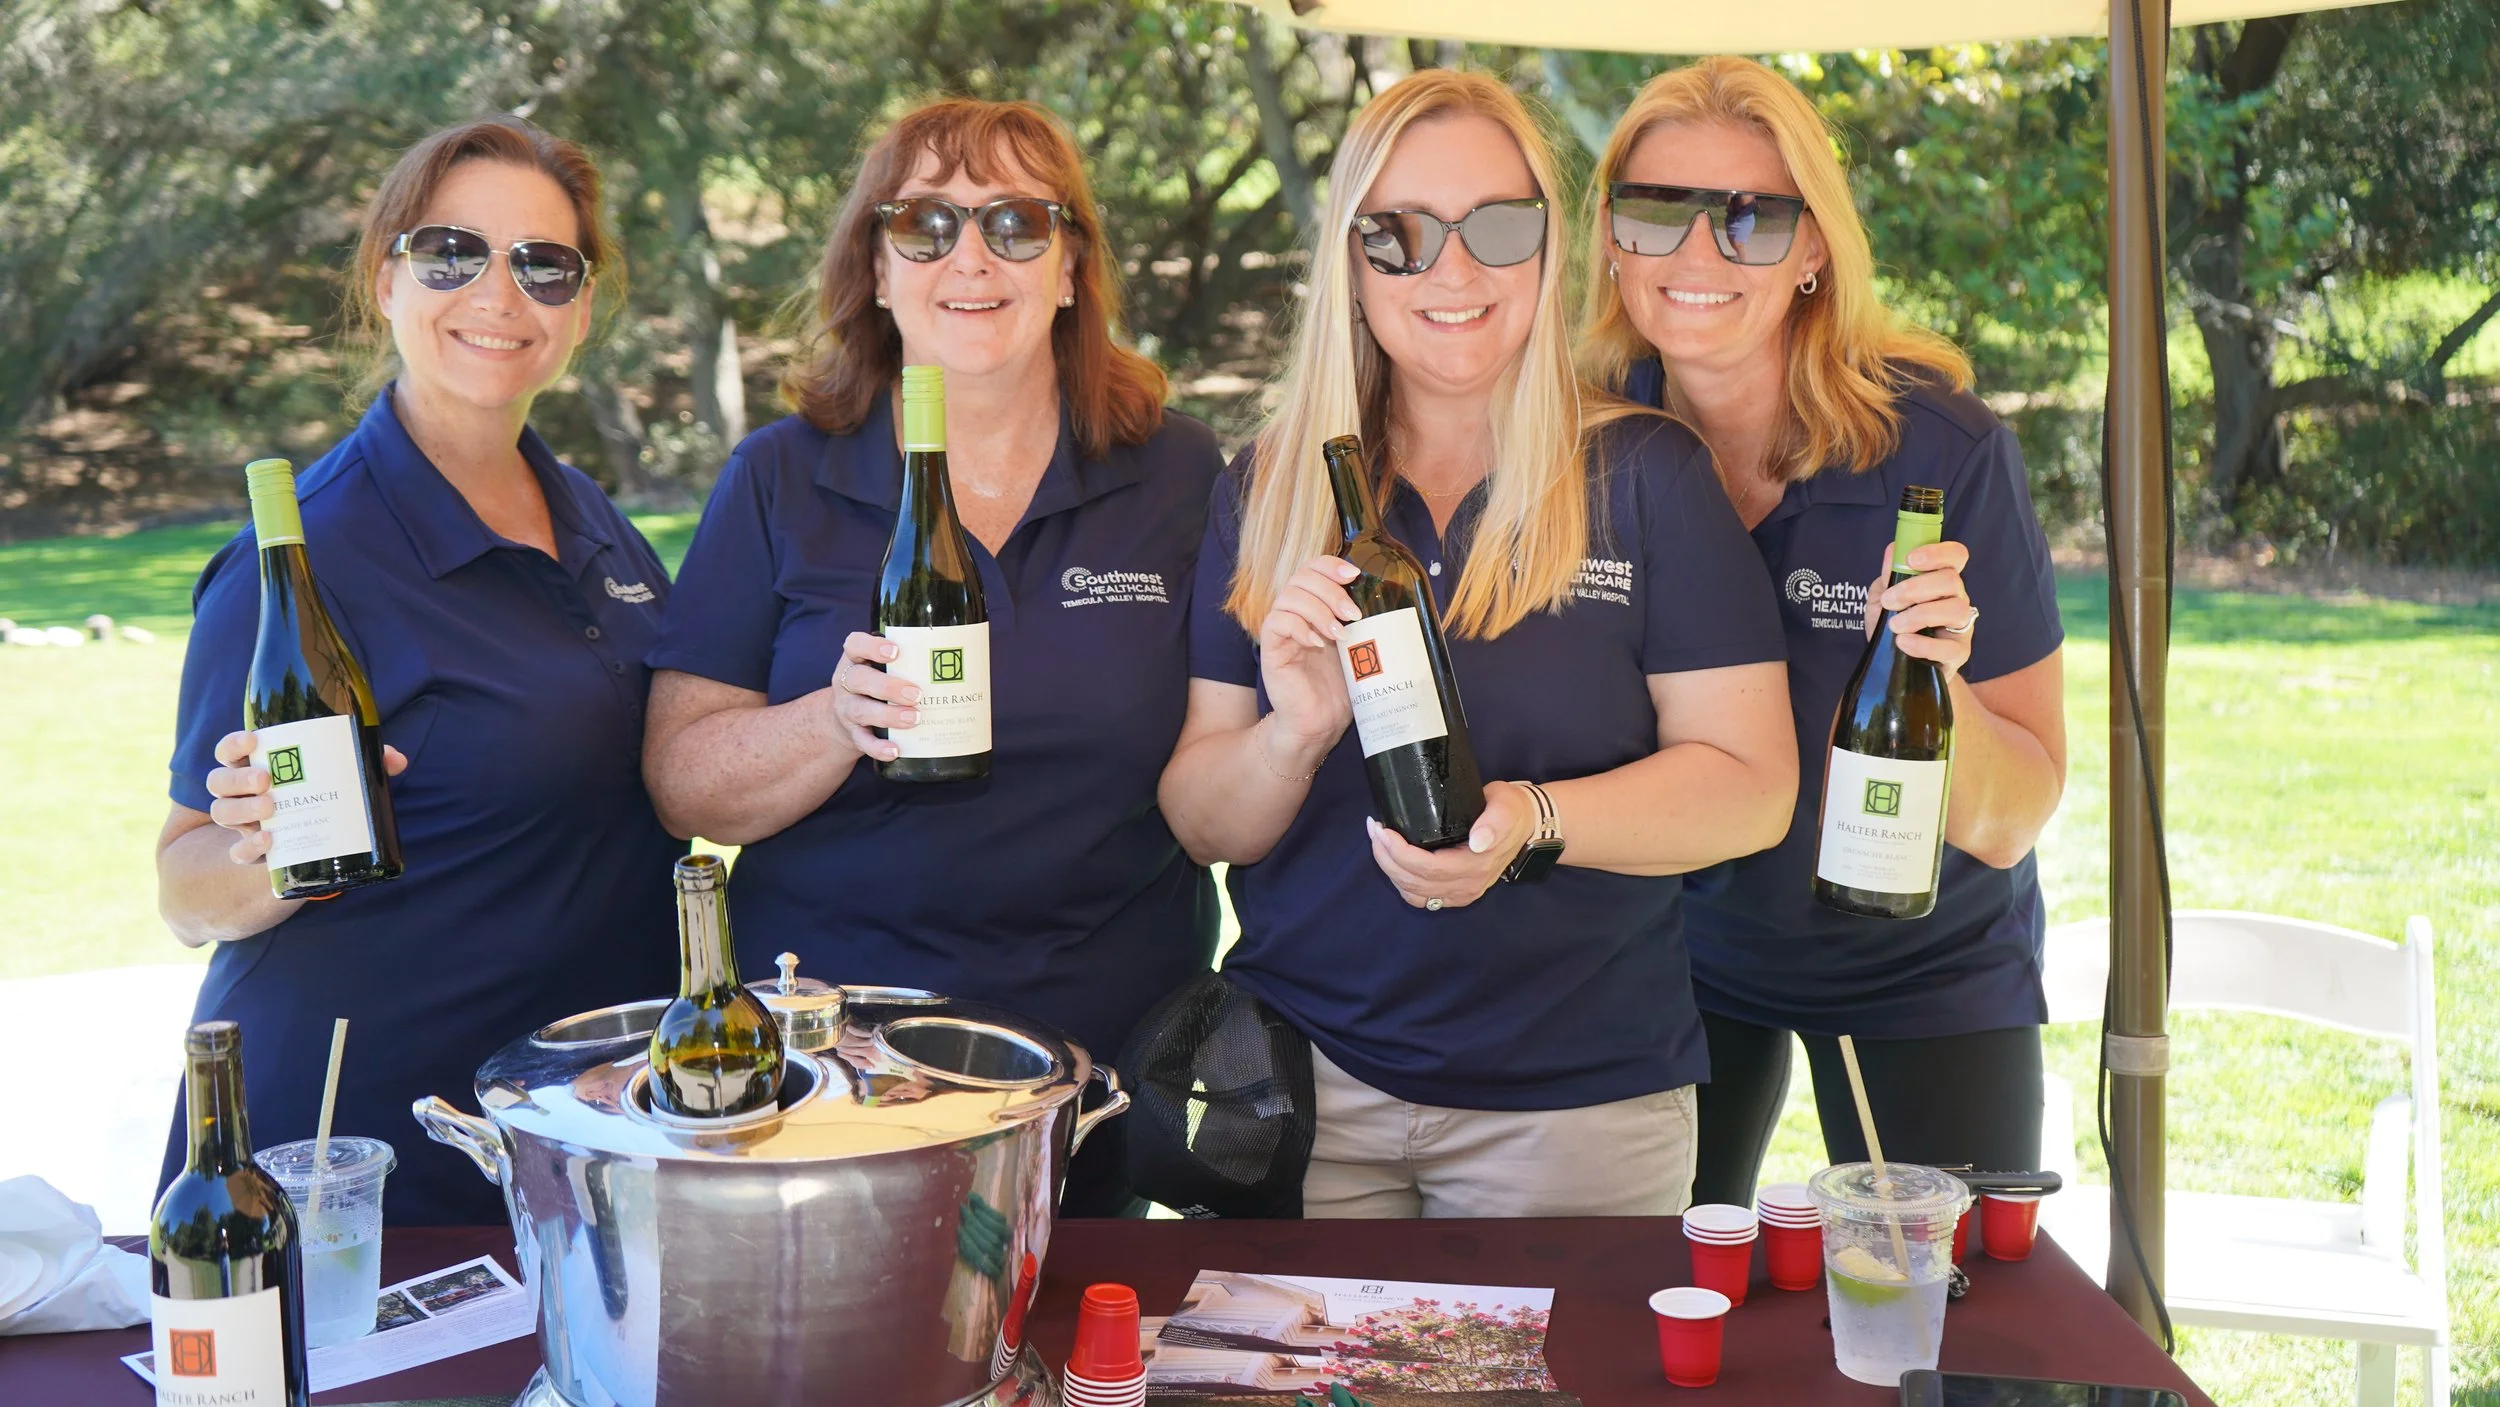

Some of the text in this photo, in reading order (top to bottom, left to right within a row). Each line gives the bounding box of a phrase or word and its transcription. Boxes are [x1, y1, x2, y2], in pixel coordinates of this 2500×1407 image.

[1074, 570, 1164, 587] Southwest
[1089, 584, 1166, 595] HEALTHCARE
[1577, 588, 1600, 600] VALLEY
[1602, 590, 1630, 606] HOSPITAL
[1799, 580, 1868, 600] Southw
[1061, 594, 1170, 609] TEMECULA VALLEY HOSPITAL
[1812, 599, 1865, 614] HEALTH
[1811, 618, 1864, 630] TEMECULA VALLE
[1373, 680, 1414, 698] RANCH
[919, 692, 984, 706] ALTER RANCH
[273, 800, 292, 811] TER
[294, 791, 339, 807] RANCH
[1836, 820, 1878, 837] HALTER
[1881, 829, 1922, 841] RANCH
[198, 1388, 255, 1406] RANCH
